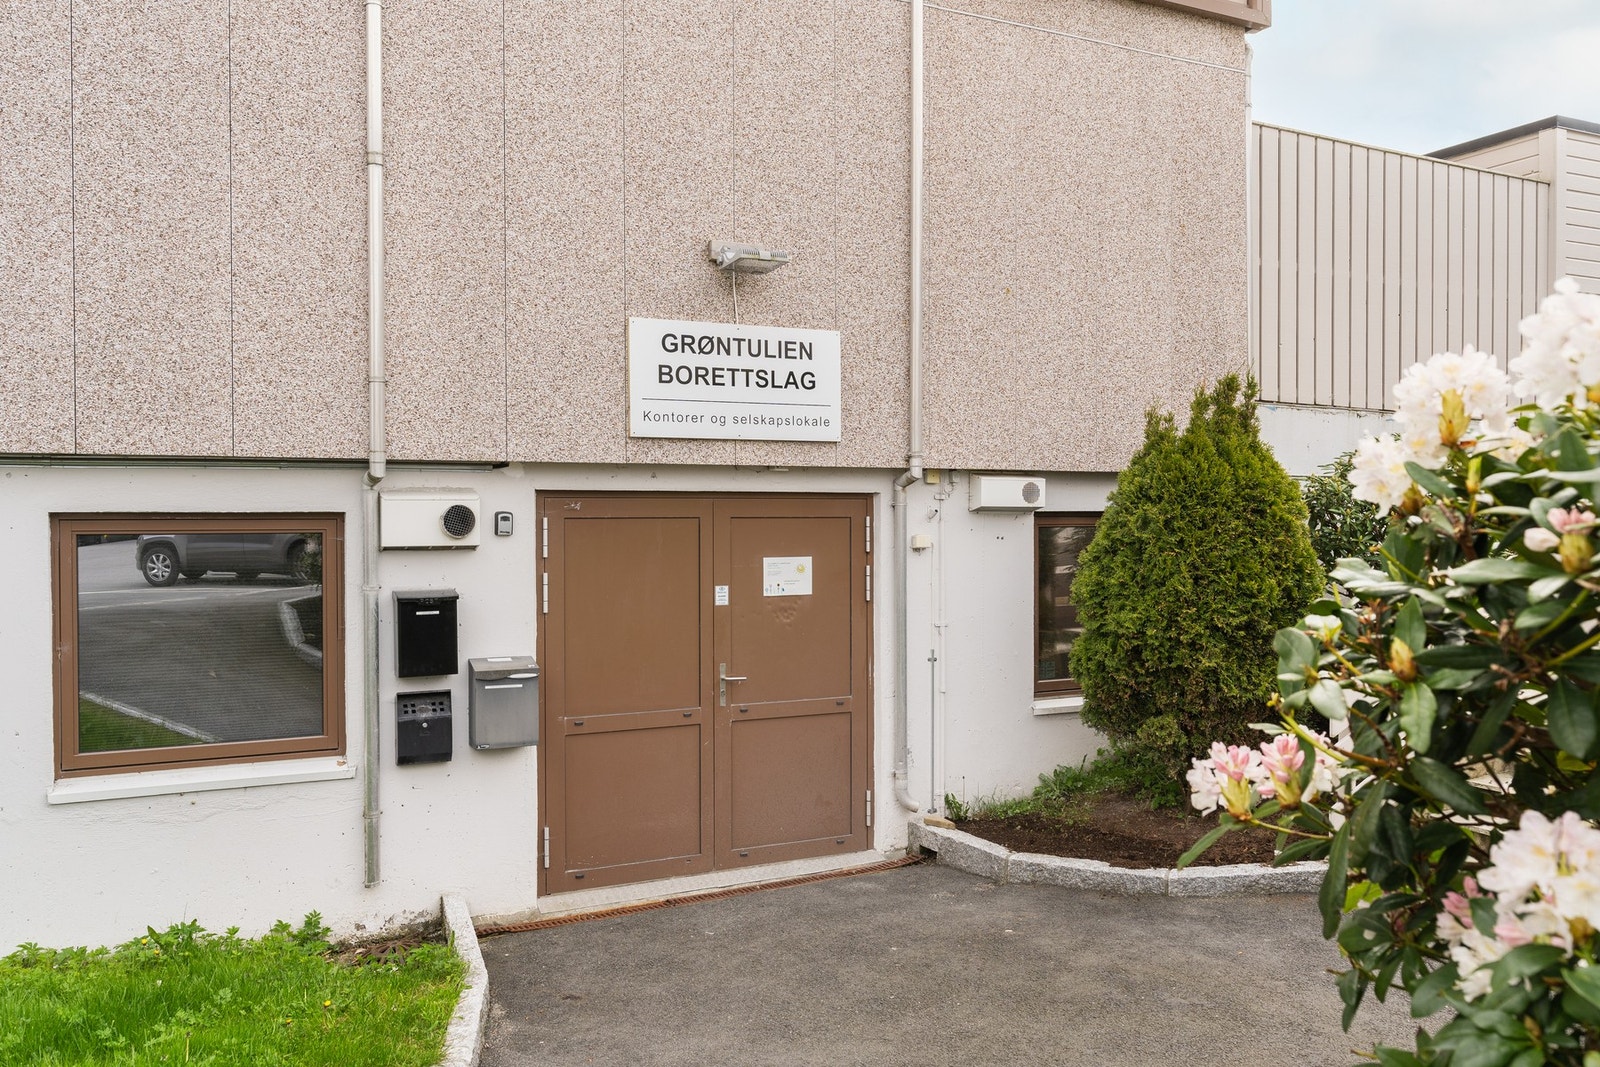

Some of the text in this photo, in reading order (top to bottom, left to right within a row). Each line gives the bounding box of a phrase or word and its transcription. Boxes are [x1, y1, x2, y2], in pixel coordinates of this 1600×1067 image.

[661, 333, 813, 360] GRØNTULIEN
[658, 364, 816, 390] BORETTSLAG
[643, 410, 831, 428] Kontorer og selskapslokale
